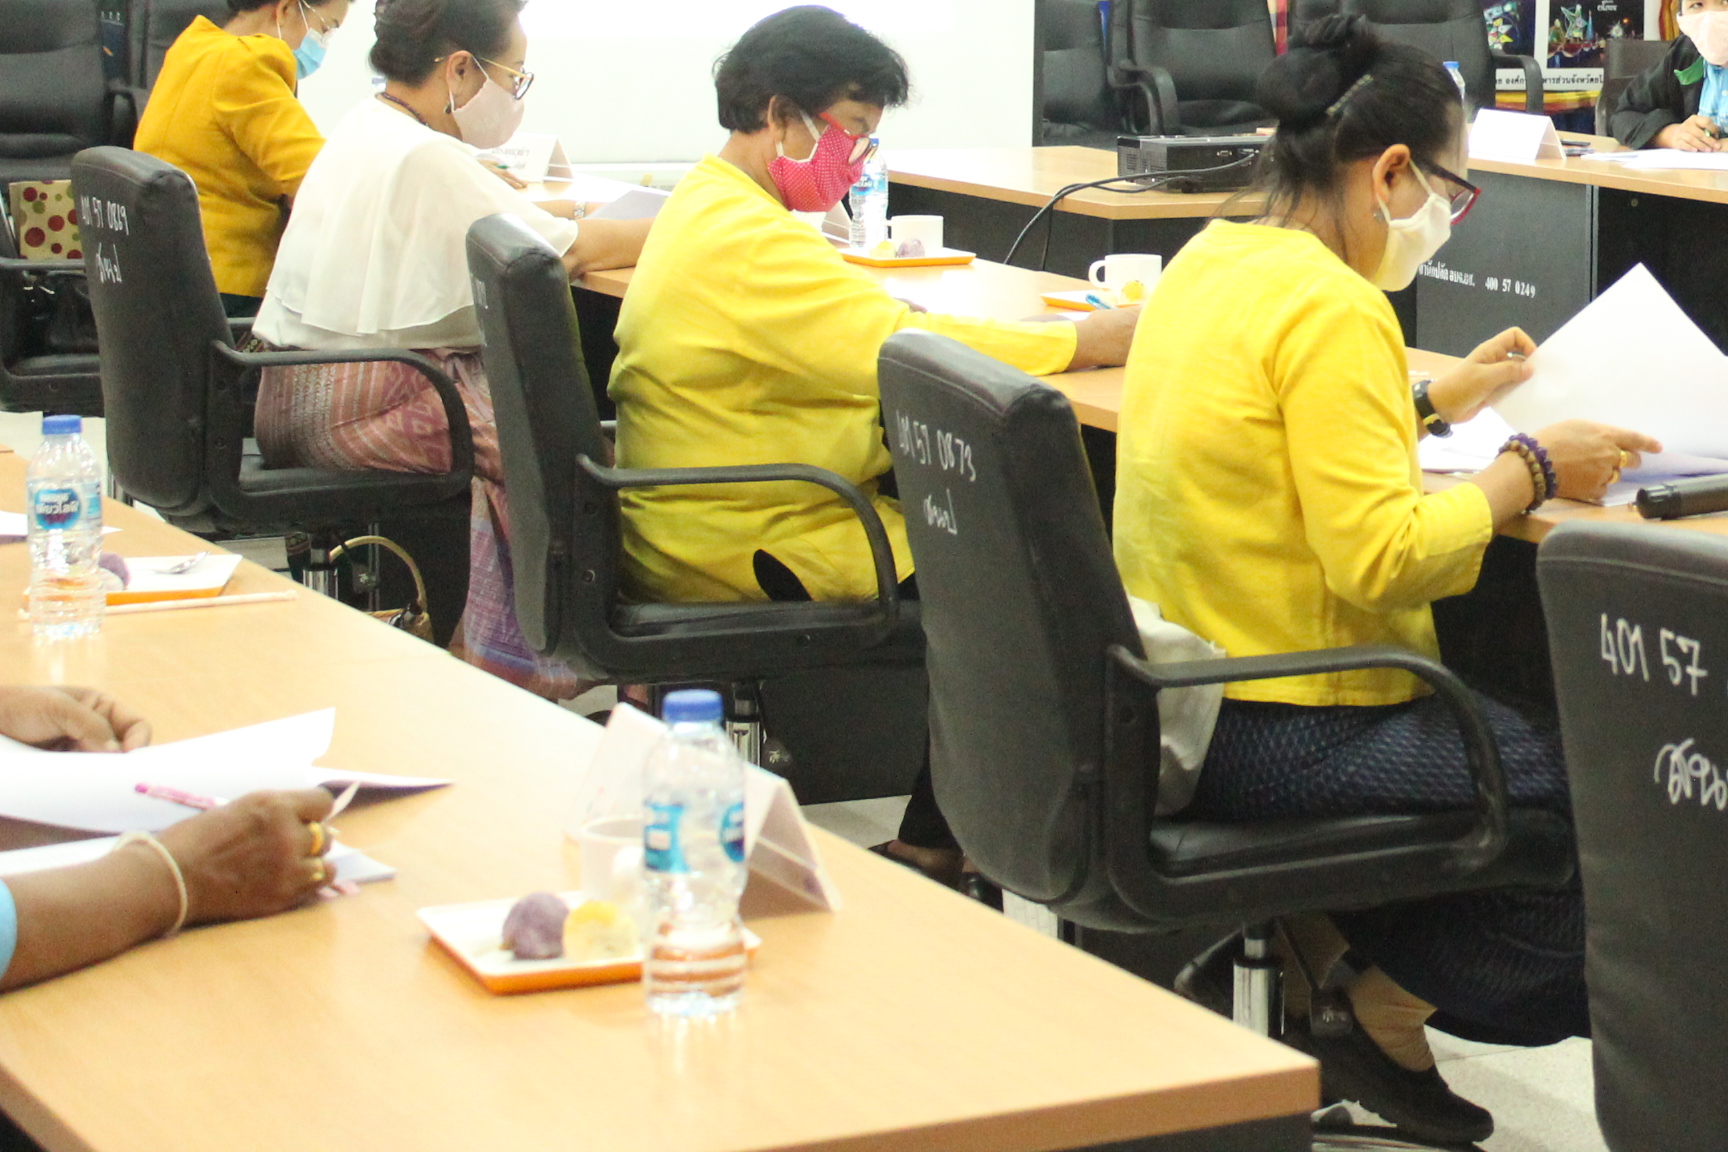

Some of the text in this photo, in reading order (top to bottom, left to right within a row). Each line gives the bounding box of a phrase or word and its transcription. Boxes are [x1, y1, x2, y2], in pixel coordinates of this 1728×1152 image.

[1484, 276, 1499, 291] 400
[1502, 278, 1512, 292] 57
[1514, 280, 1536, 298] 0249
[1659, 627, 1709, 696] 57
